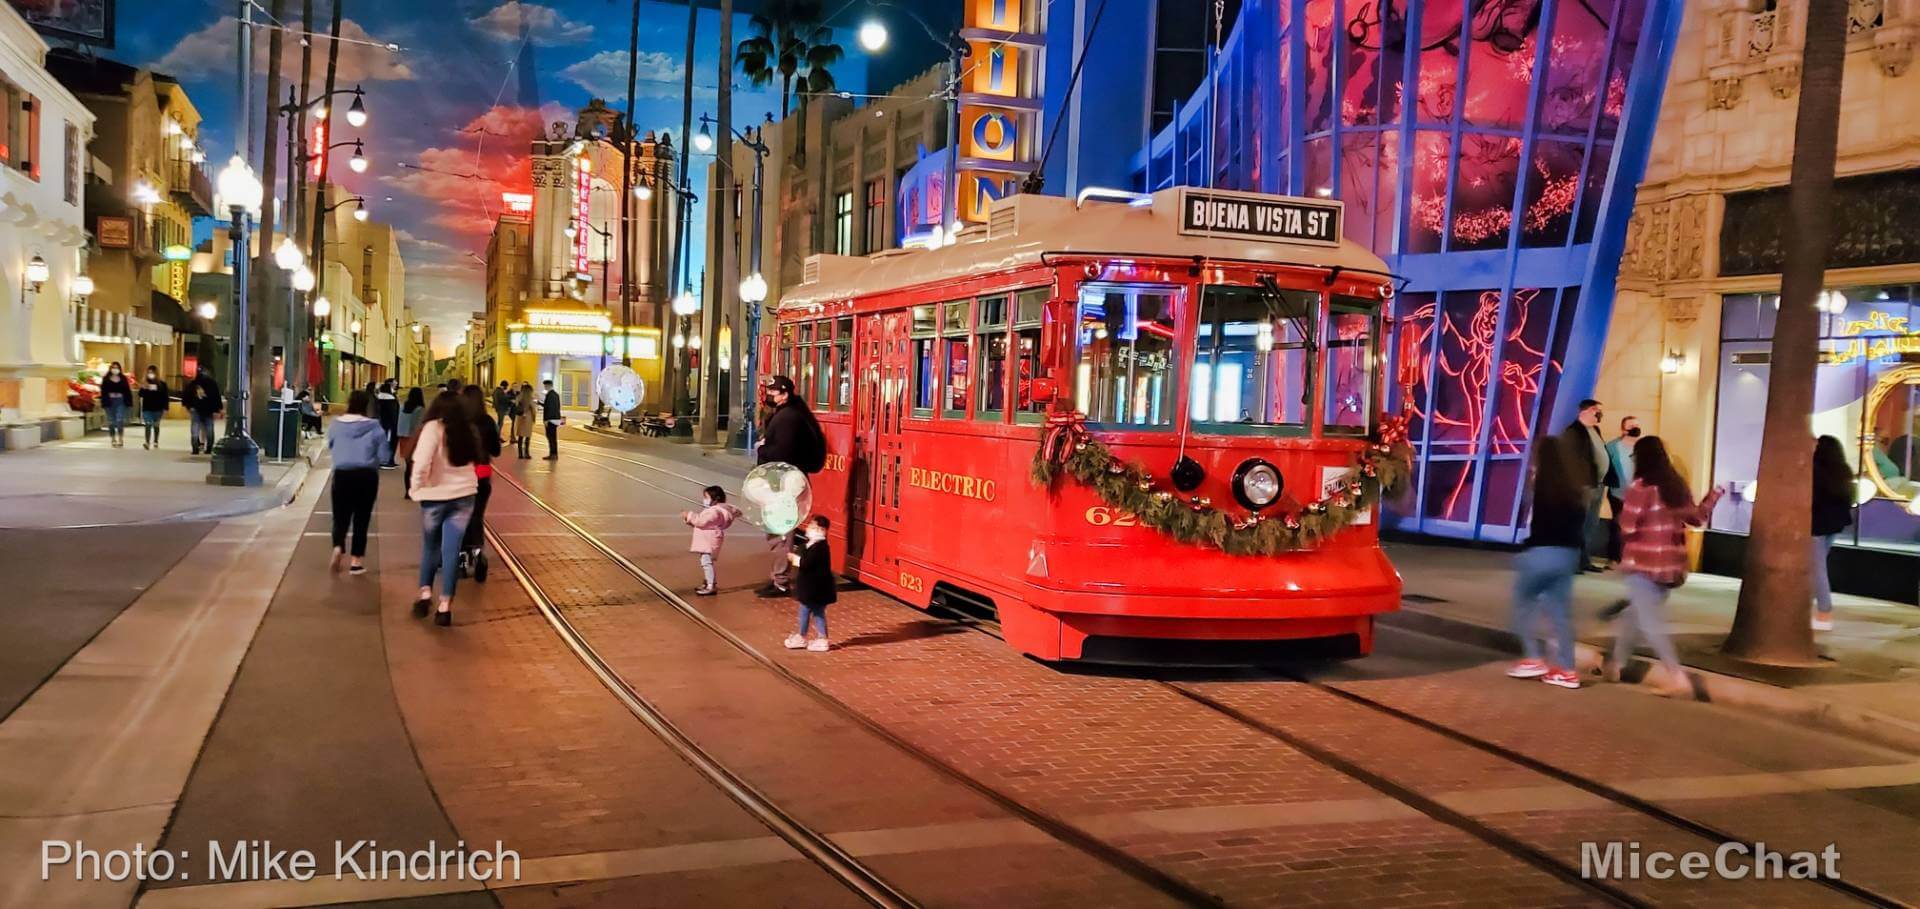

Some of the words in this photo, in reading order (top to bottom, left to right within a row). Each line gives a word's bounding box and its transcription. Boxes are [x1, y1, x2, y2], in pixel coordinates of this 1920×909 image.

[1192, 200, 1250, 230] BUENA
[1255, 205, 1302, 234] VISTA
[1307, 211, 1329, 236] ST
[909, 467, 996, 502] ELECTRIC
[1085, 506, 1161, 528] 62
[900, 572, 923, 593] 623
